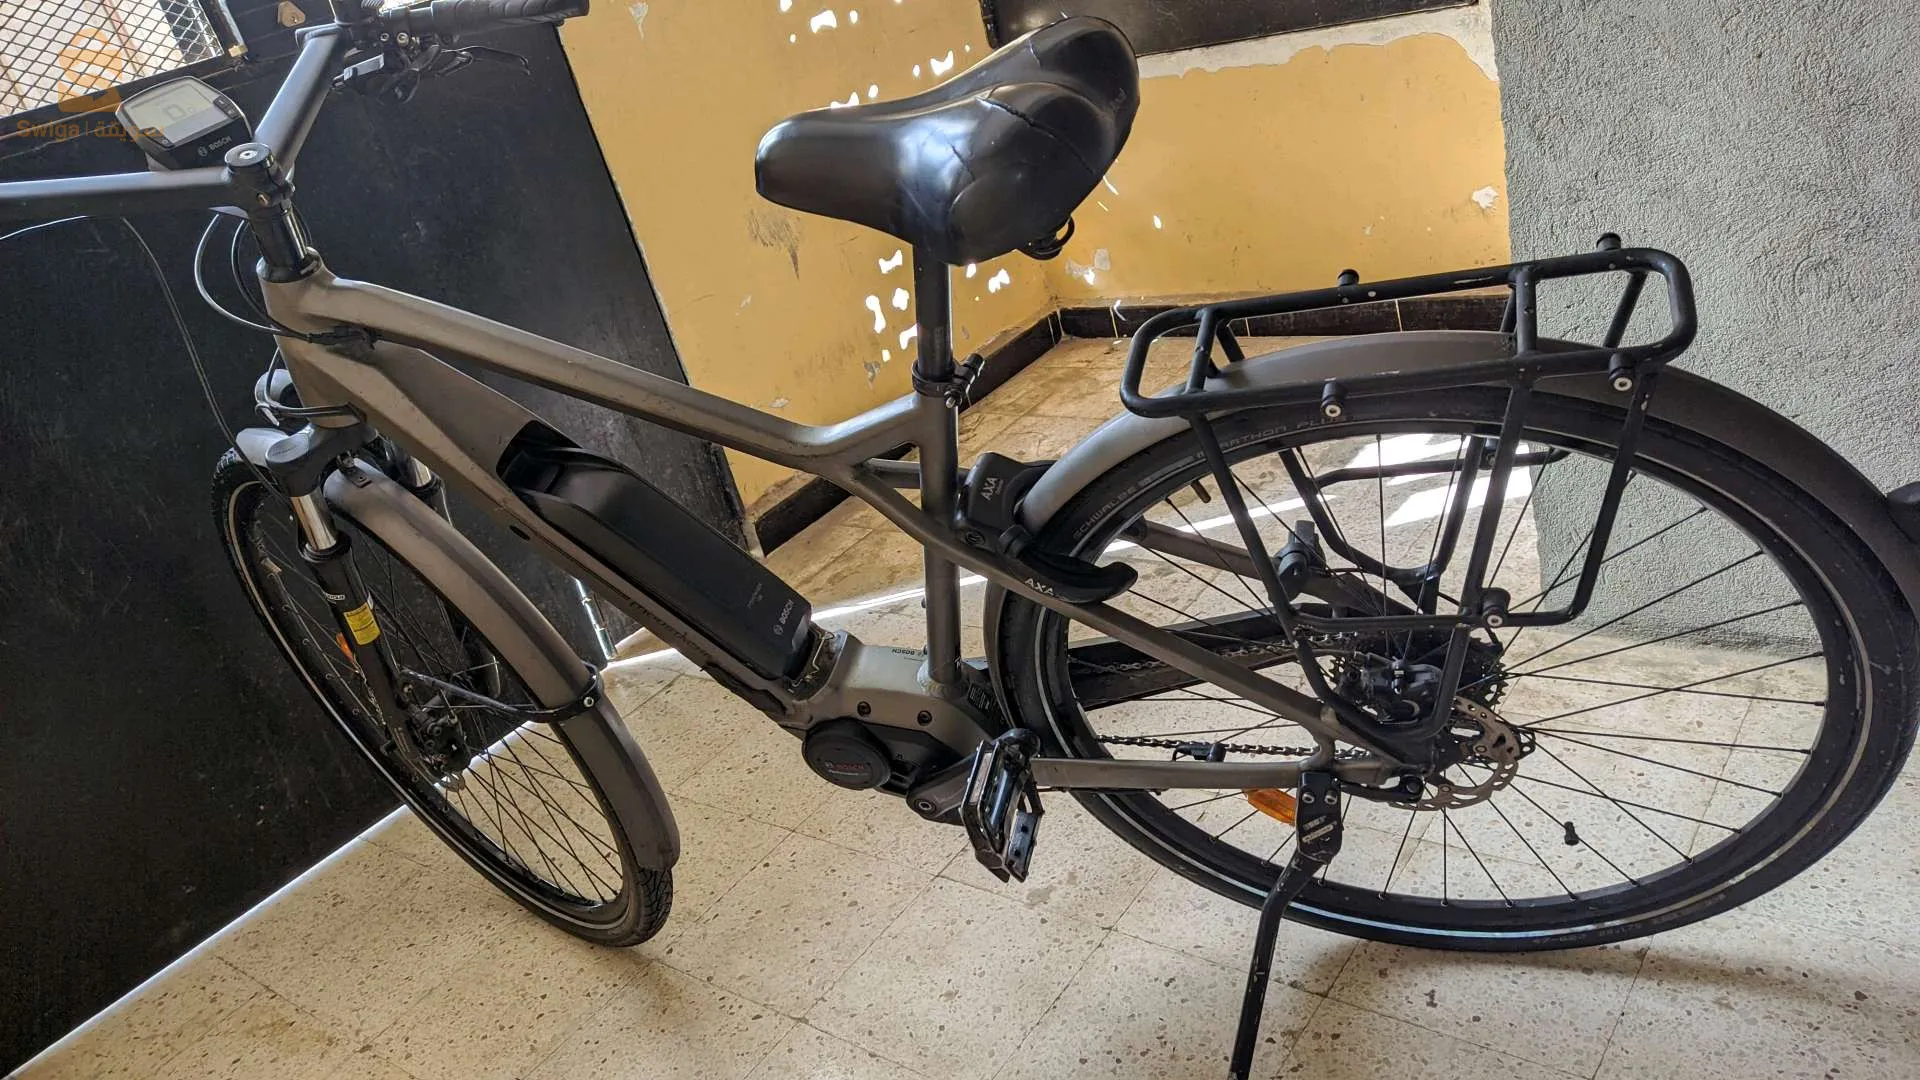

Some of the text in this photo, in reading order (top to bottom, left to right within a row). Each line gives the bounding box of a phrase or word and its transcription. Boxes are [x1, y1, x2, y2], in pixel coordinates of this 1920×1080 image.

[208, 135, 233, 151] BOSCH
[981, 477, 998, 501] AXA
[1024, 577, 1055, 597] AXA
[779, 599, 795, 625] BOSCH
